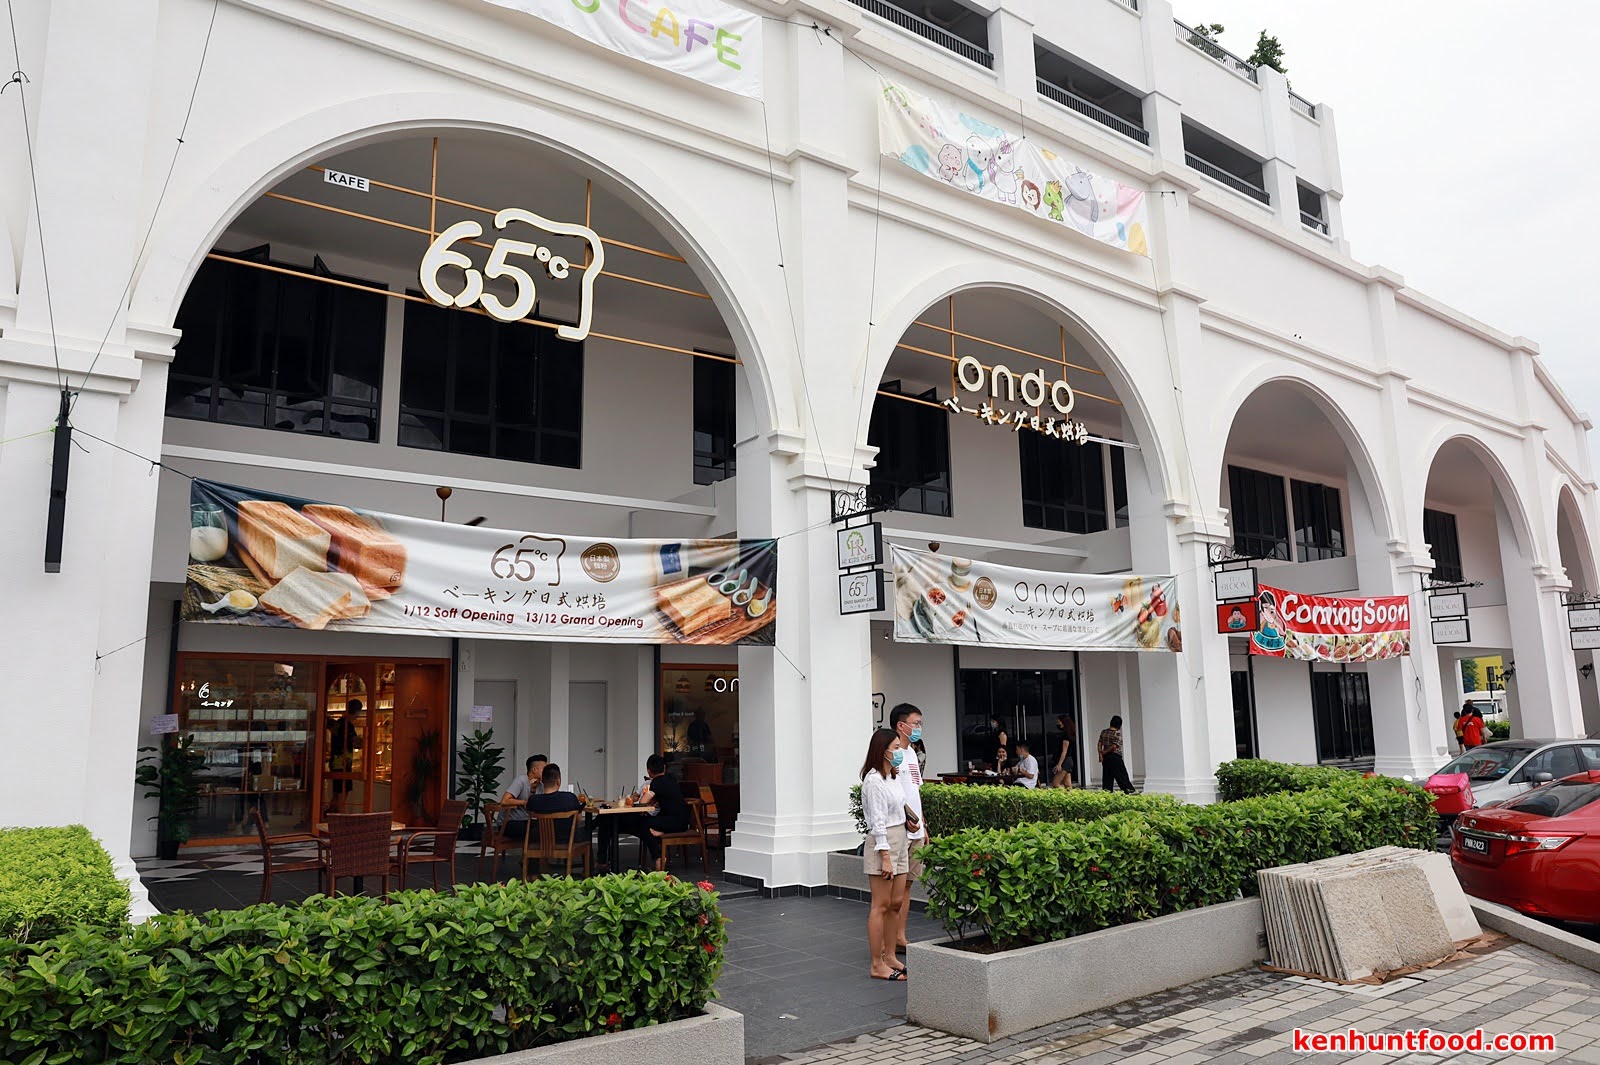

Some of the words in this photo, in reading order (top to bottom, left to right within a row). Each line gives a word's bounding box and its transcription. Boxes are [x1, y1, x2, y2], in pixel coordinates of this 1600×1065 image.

[619, 0, 742, 71] CAFE
[328, 171, 366, 189] KAFE
[956, 355, 1075, 414] ondo
[1014, 582, 1086, 606] ondo
[403, 605, 430, 617] 1/12
[433, 606, 458, 619] Soft
[461, 608, 515, 624] Opening
[525, 612, 557, 624] 13/12
[560, 614, 595, 625] Grand
[598, 616, 644, 629] Opening
